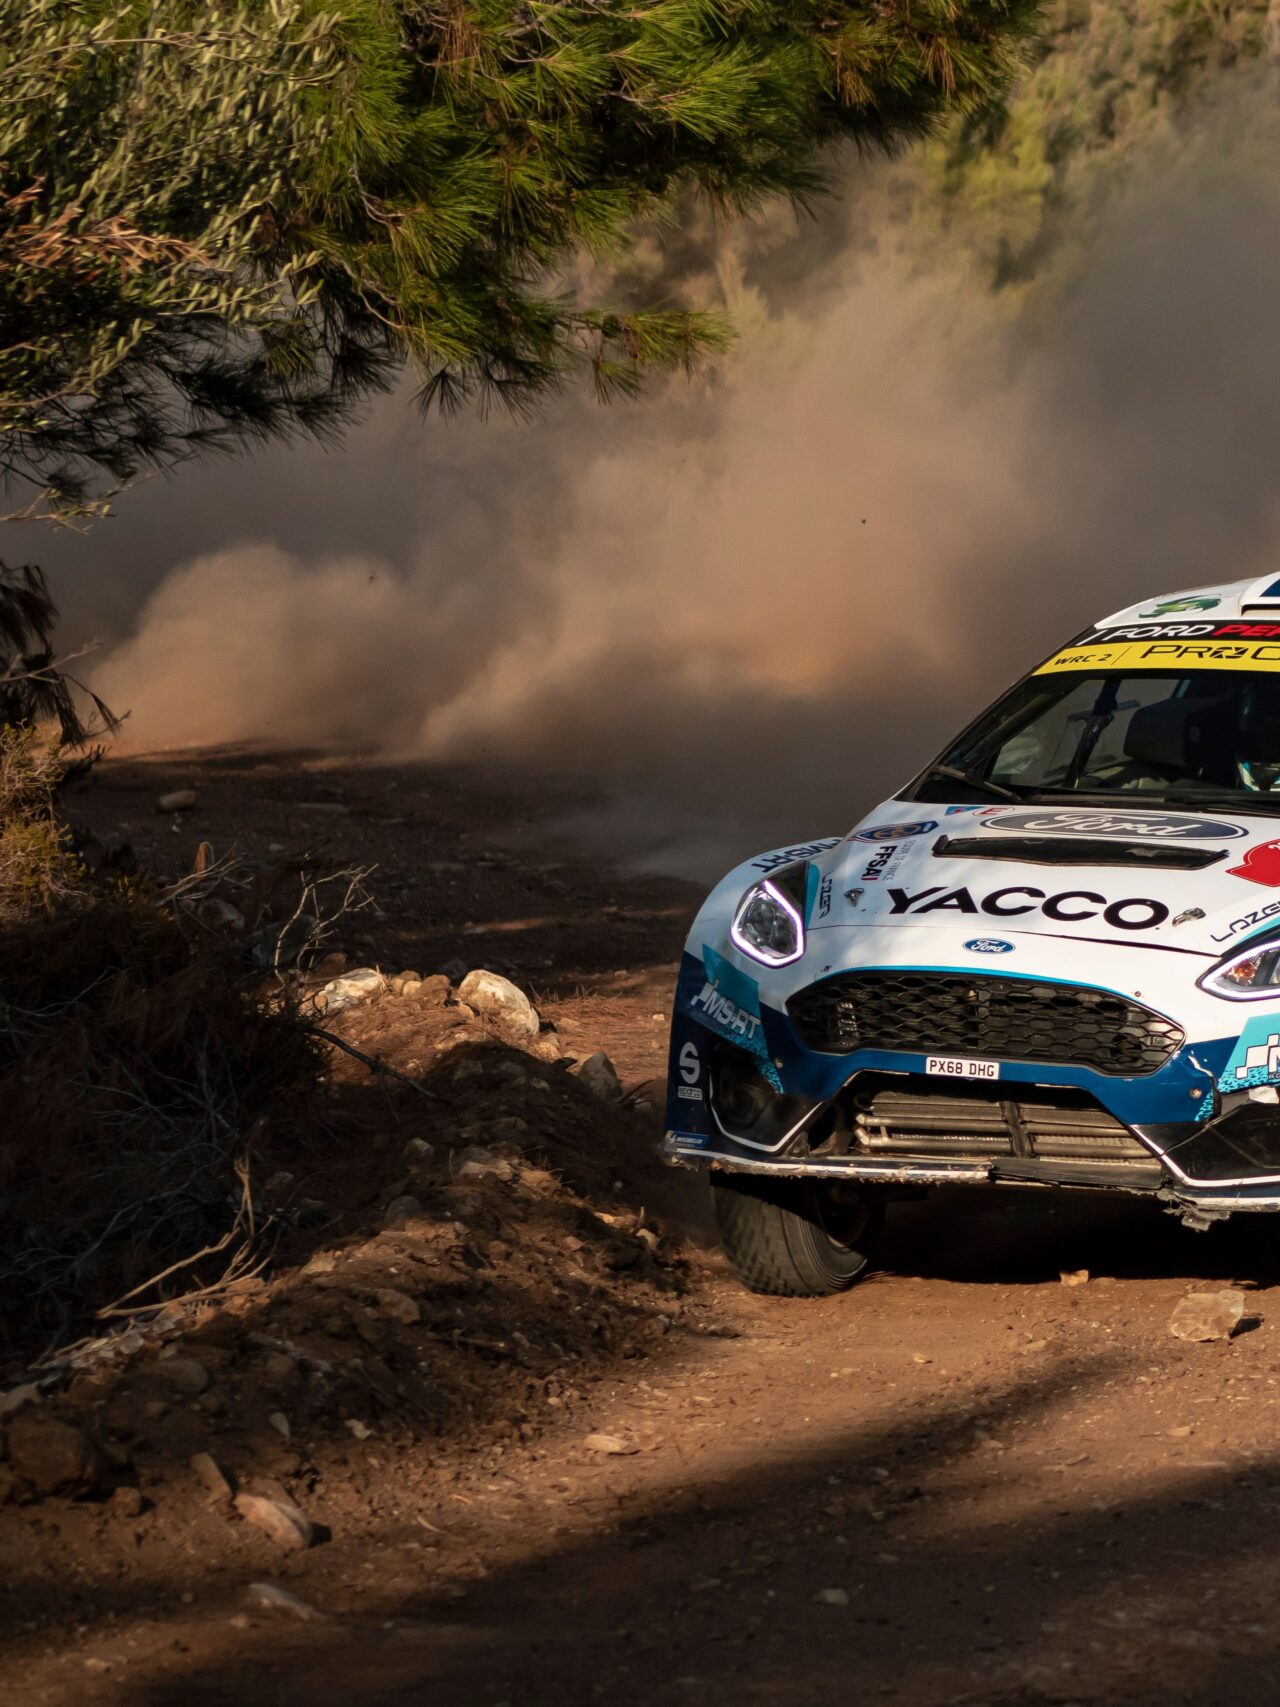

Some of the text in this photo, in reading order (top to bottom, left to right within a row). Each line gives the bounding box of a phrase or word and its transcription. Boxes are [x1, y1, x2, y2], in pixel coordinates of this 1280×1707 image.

[1101, 624, 1215, 641] FORD
[1054, 653, 1112, 666] WRC 2
[1024, 813, 1202, 836] Ford
[862, 845, 898, 878] FFSA
[886, 886, 1170, 931] YACCO
[970, 939, 1008, 953] Ford
[929, 1060, 995, 1077] PX68 DHG
